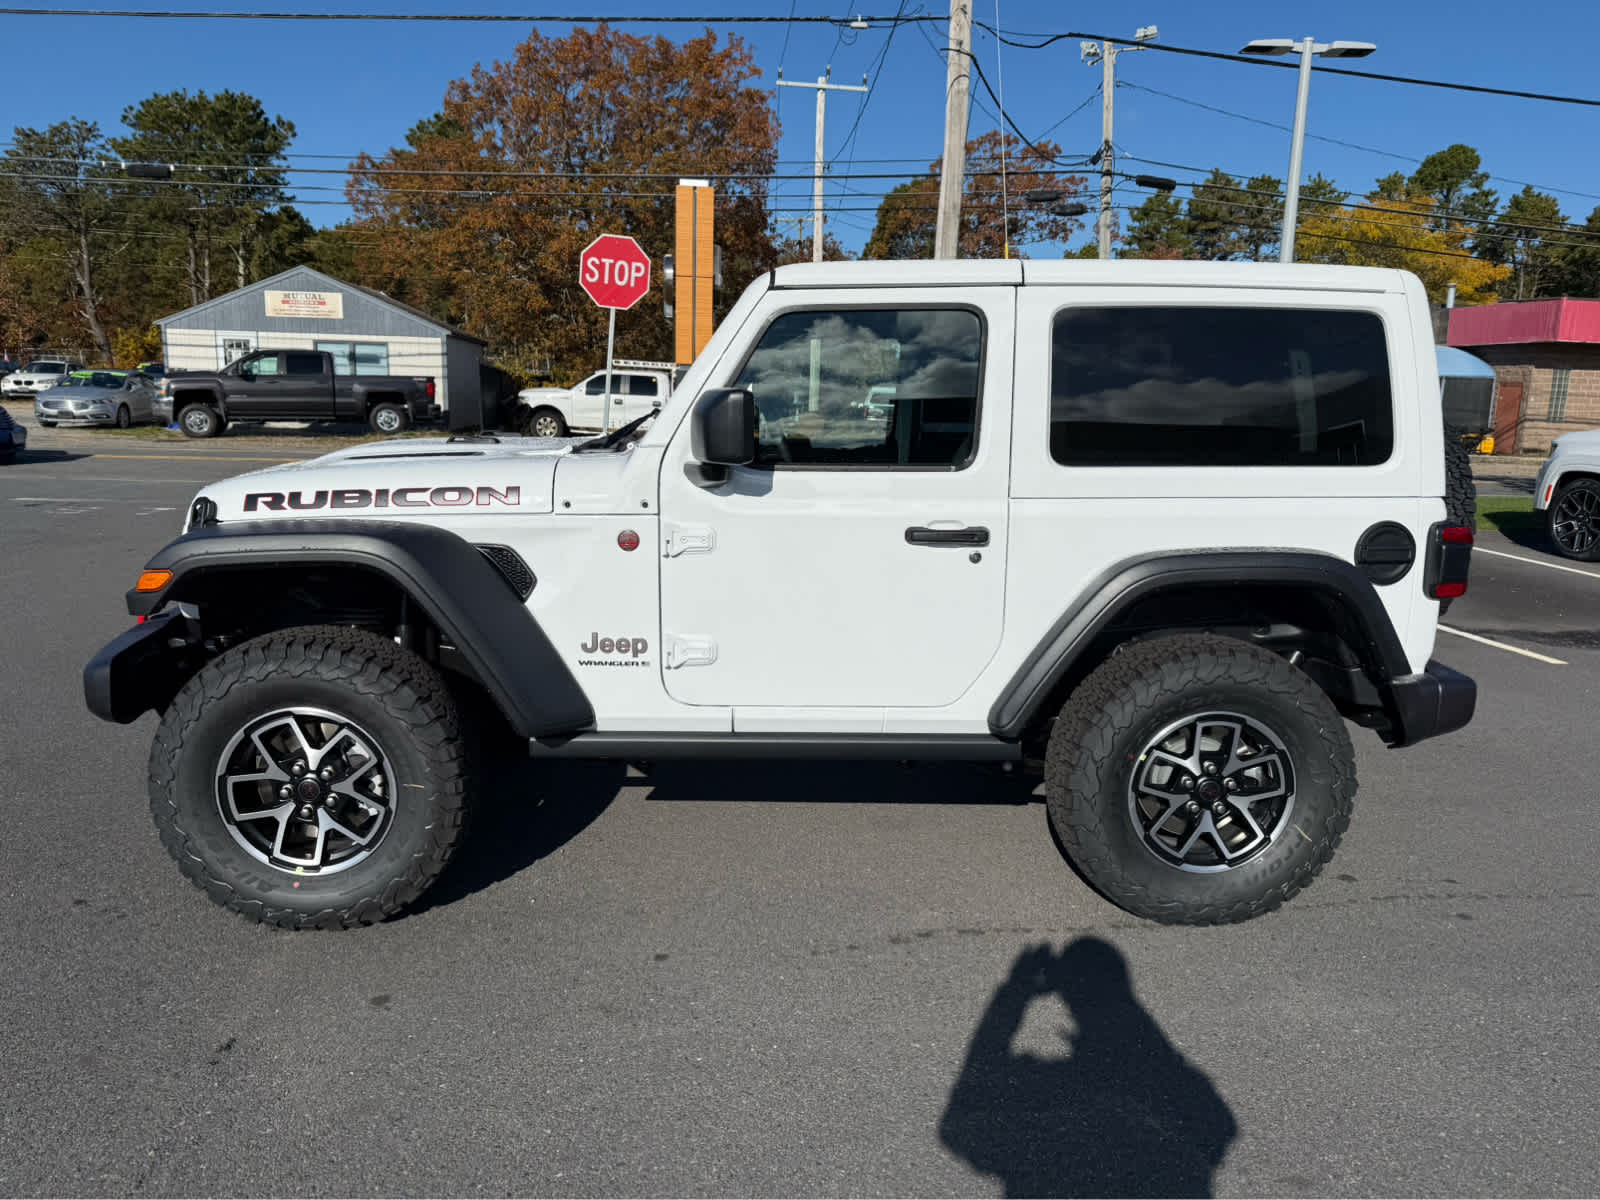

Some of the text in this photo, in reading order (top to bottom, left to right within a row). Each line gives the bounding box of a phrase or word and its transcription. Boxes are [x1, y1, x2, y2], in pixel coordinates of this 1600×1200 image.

[585, 256, 646, 287] STOP
[243, 486, 520, 512] RUBICON
[581, 632, 648, 658] Jeep
